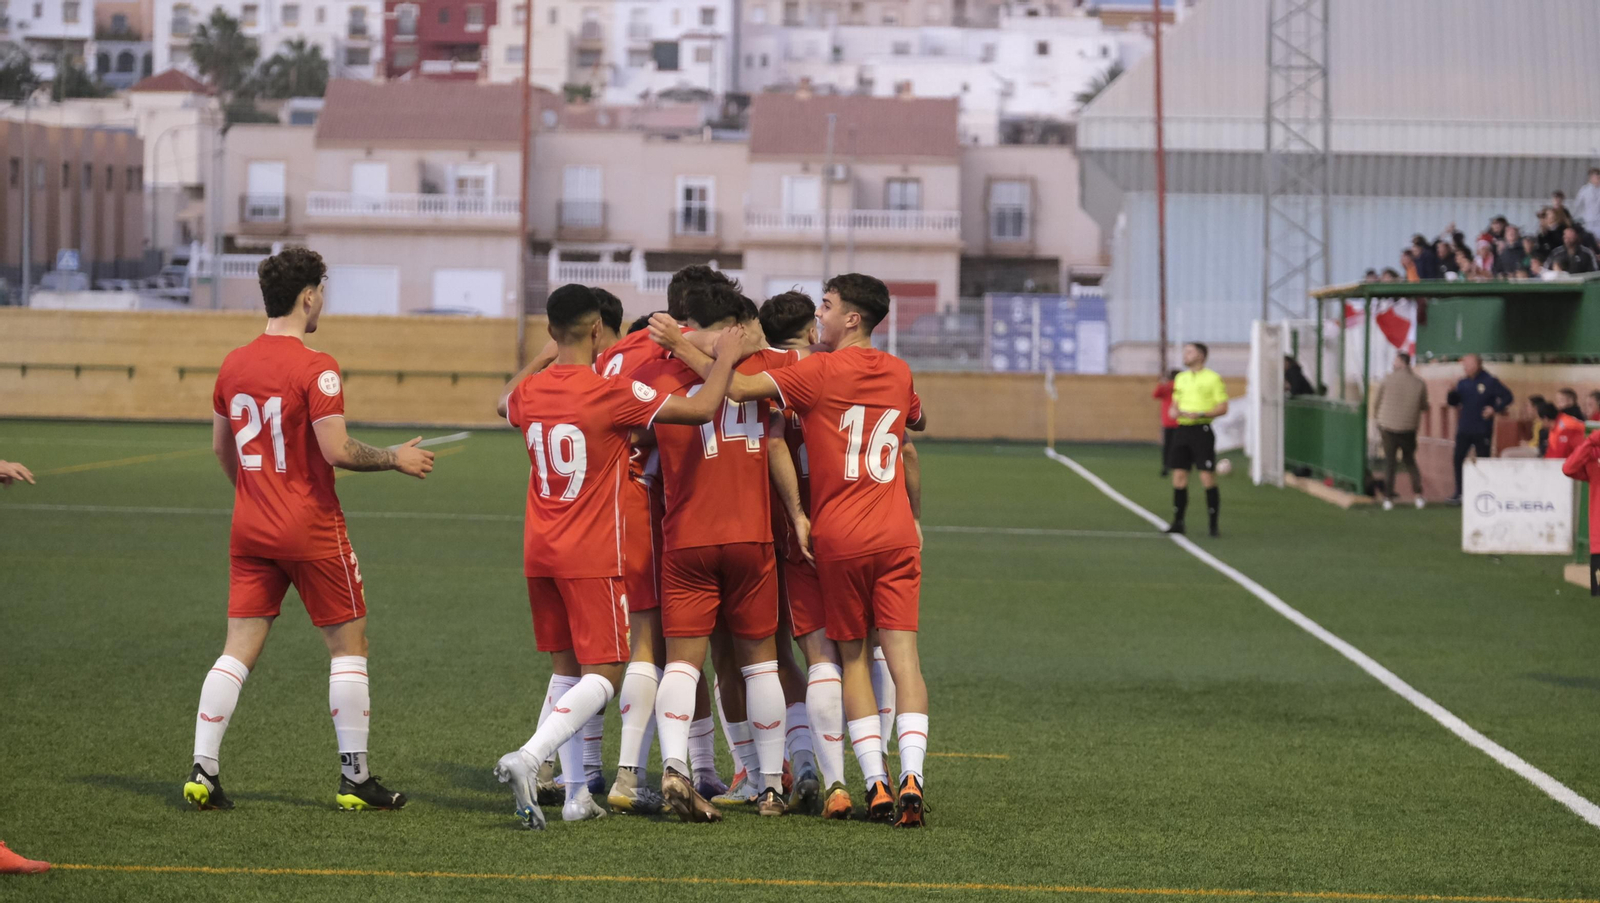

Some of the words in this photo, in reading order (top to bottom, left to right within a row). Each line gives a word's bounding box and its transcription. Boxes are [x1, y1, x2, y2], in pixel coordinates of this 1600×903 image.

[231, 394, 286, 472] 21
[527, 422, 587, 501] 19
[838, 404, 901, 484] 16
[350, 552, 362, 584] 2
[619, 593, 630, 627] 1
